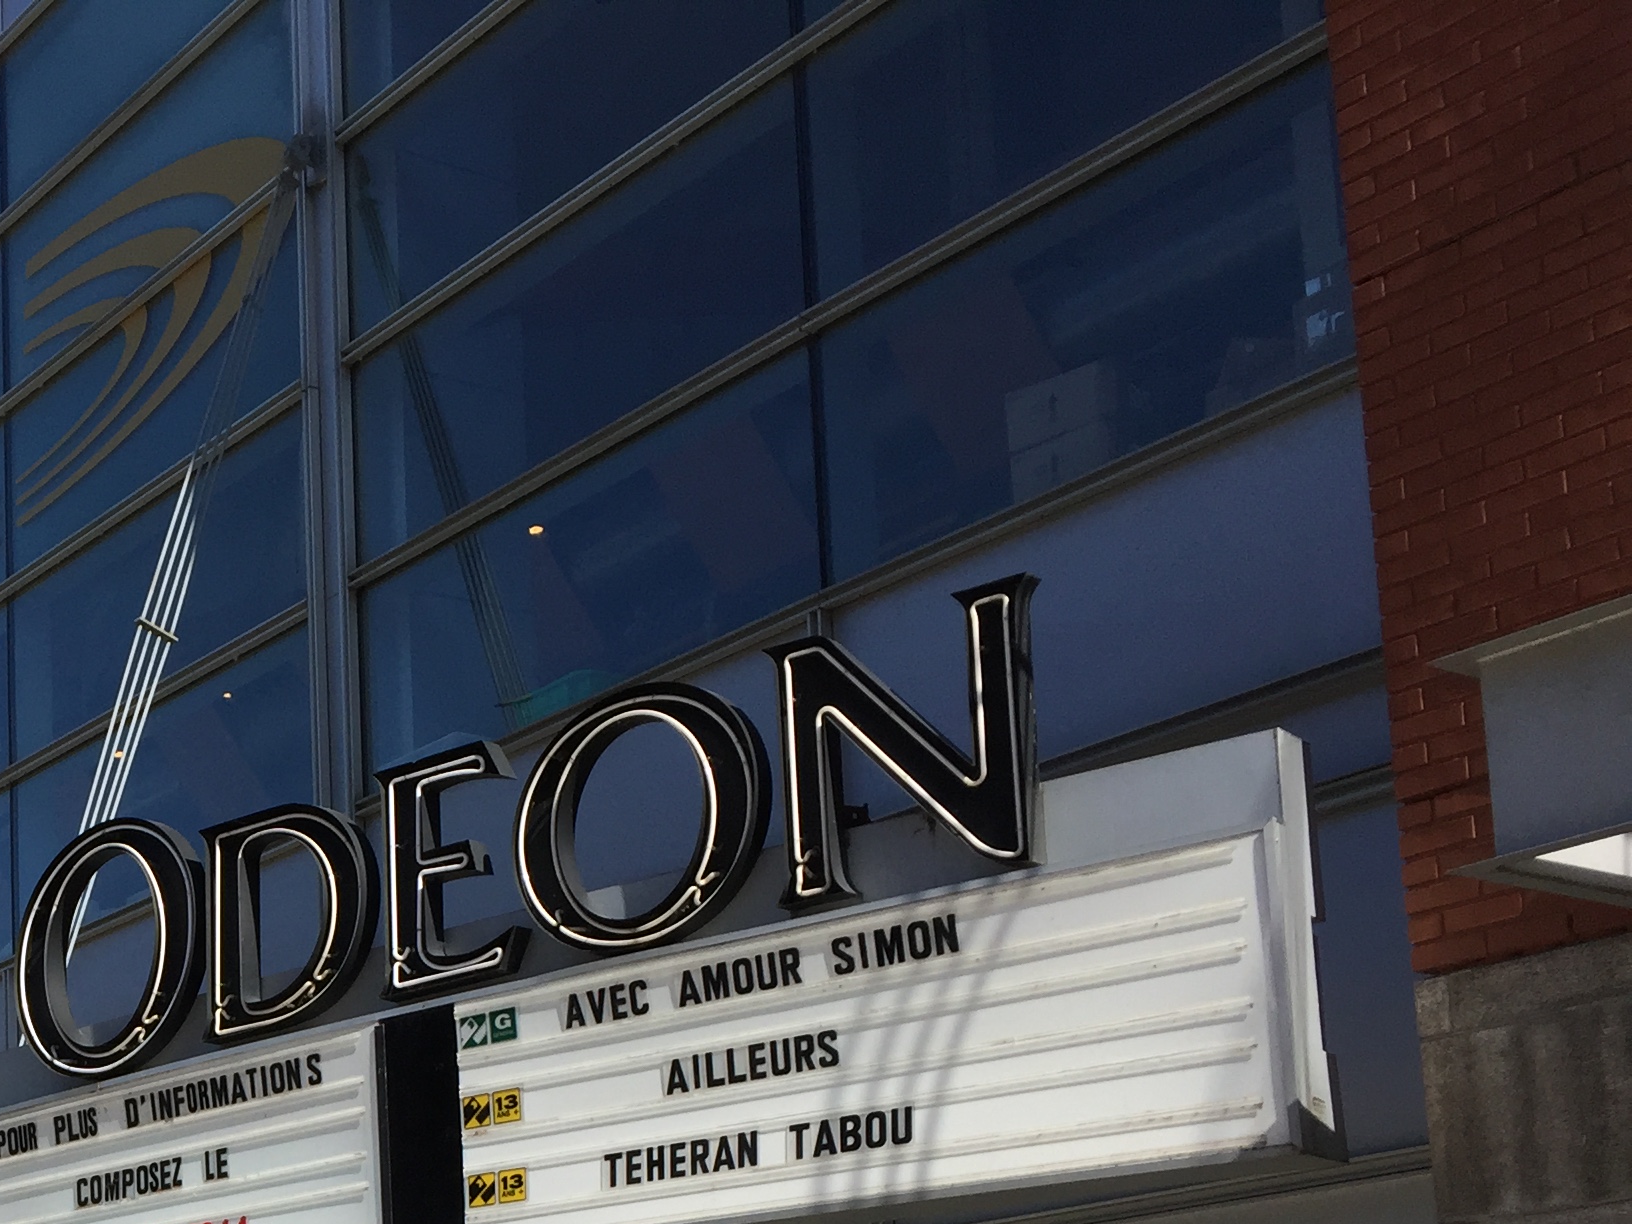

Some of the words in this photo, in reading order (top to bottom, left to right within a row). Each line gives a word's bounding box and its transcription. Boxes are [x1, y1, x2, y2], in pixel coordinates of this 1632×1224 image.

[16, 573, 1047, 1080] ODEON
[566, 980, 650, 1029] AVEC
[679, 947, 802, 1007] AMOUR
[831, 913, 960, 975] SIMON
[494, 1013, 512, 1030] G
[667, 1030, 840, 1095] AILLEURS
[54, 1107, 98, 1144] PLUS
[126, 1053, 322, 1129] D'INFORMATIONS
[495, 1094, 518, 1111] 13
[76, 1156, 182, 1207] COMPOSEZ
[204, 1148, 228, 1182] LE
[604, 1131, 759, 1188] TEHERAN
[788, 1106, 914, 1159] TABOU
[501, 1173, 524, 1190] 13
